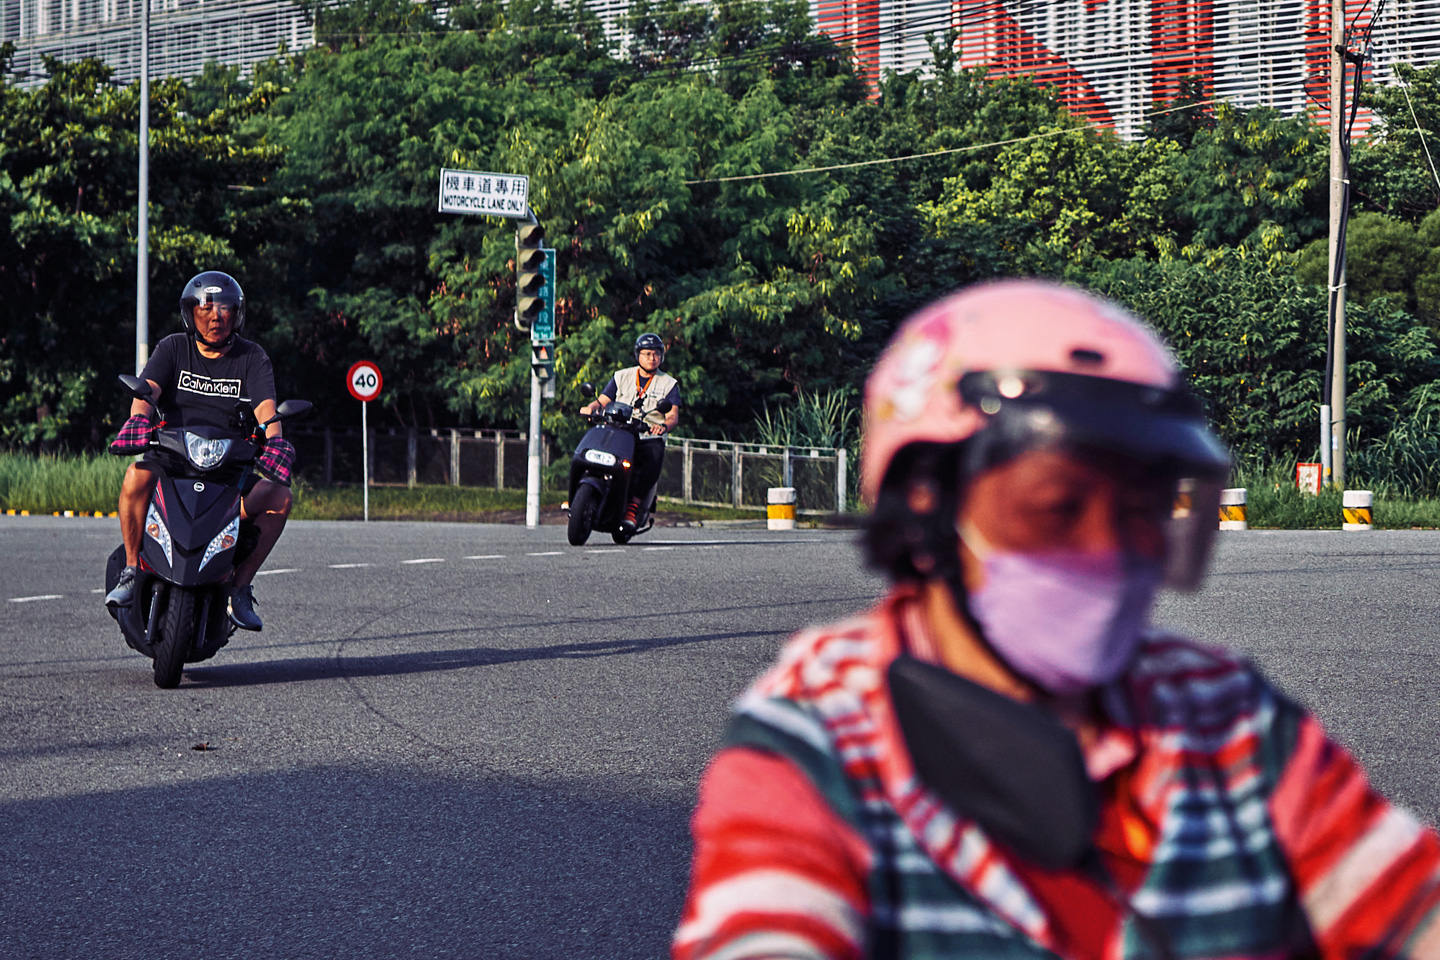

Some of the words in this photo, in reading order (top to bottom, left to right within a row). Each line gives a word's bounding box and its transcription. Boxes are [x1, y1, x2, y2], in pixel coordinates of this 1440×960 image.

[446, 175, 525, 196] 機車道專用
[444, 195, 485, 209] MOTORCYCLE
[488, 199, 505, 210] LANE
[507, 200, 523, 211] ONLY
[355, 374, 376, 388] 40
